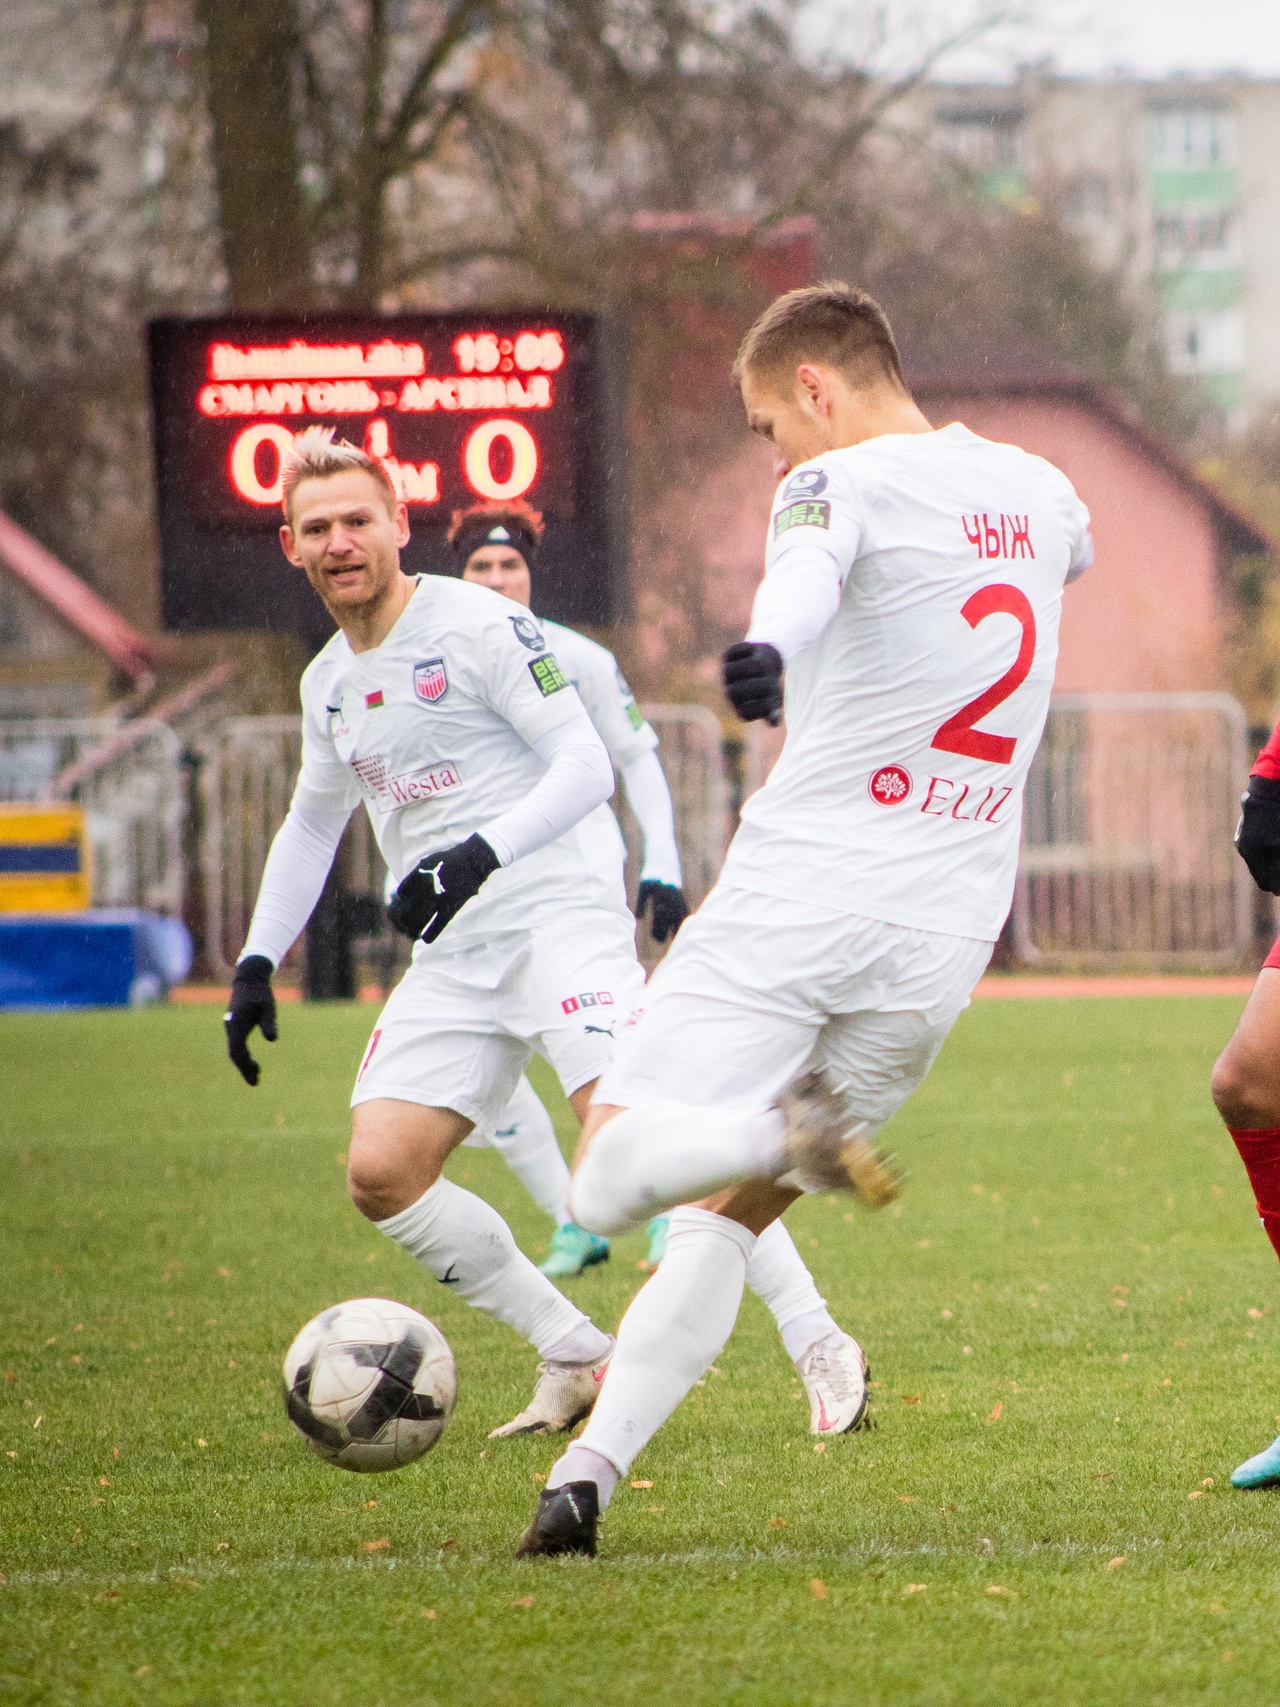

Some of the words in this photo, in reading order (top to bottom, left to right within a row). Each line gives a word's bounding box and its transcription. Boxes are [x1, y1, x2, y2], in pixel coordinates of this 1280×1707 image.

[461, 414, 541, 503] 0
[962, 513, 1036, 559] ЧЫЖ
[930, 583, 1037, 765] 2
[388, 769, 456, 804] Westa
